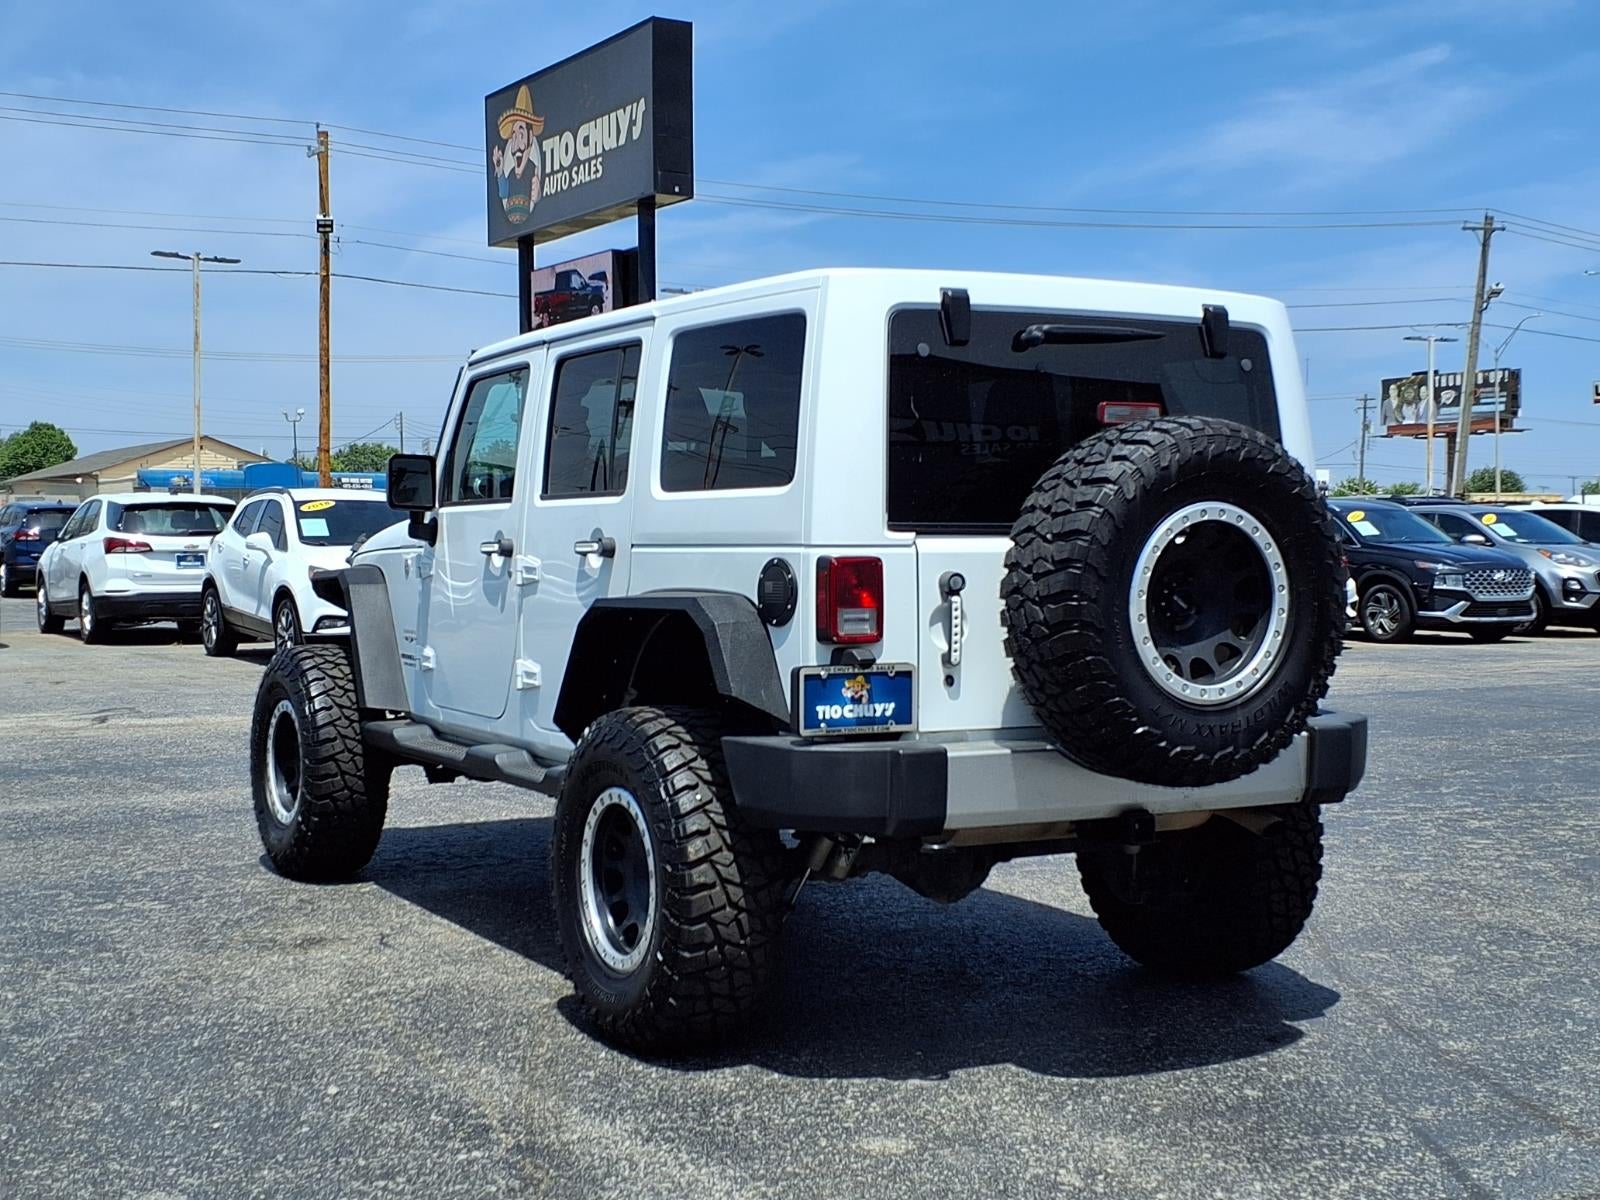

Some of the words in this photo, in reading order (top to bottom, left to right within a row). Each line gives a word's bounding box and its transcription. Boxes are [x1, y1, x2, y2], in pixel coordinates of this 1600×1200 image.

[542, 130, 575, 174] TIO
[576, 97, 646, 161] CHUY'S
[543, 171, 569, 197] AUTO
[571, 156, 603, 188] SALES
[816, 704, 842, 719] TIO
[843, 702, 895, 718] CHUY'S
